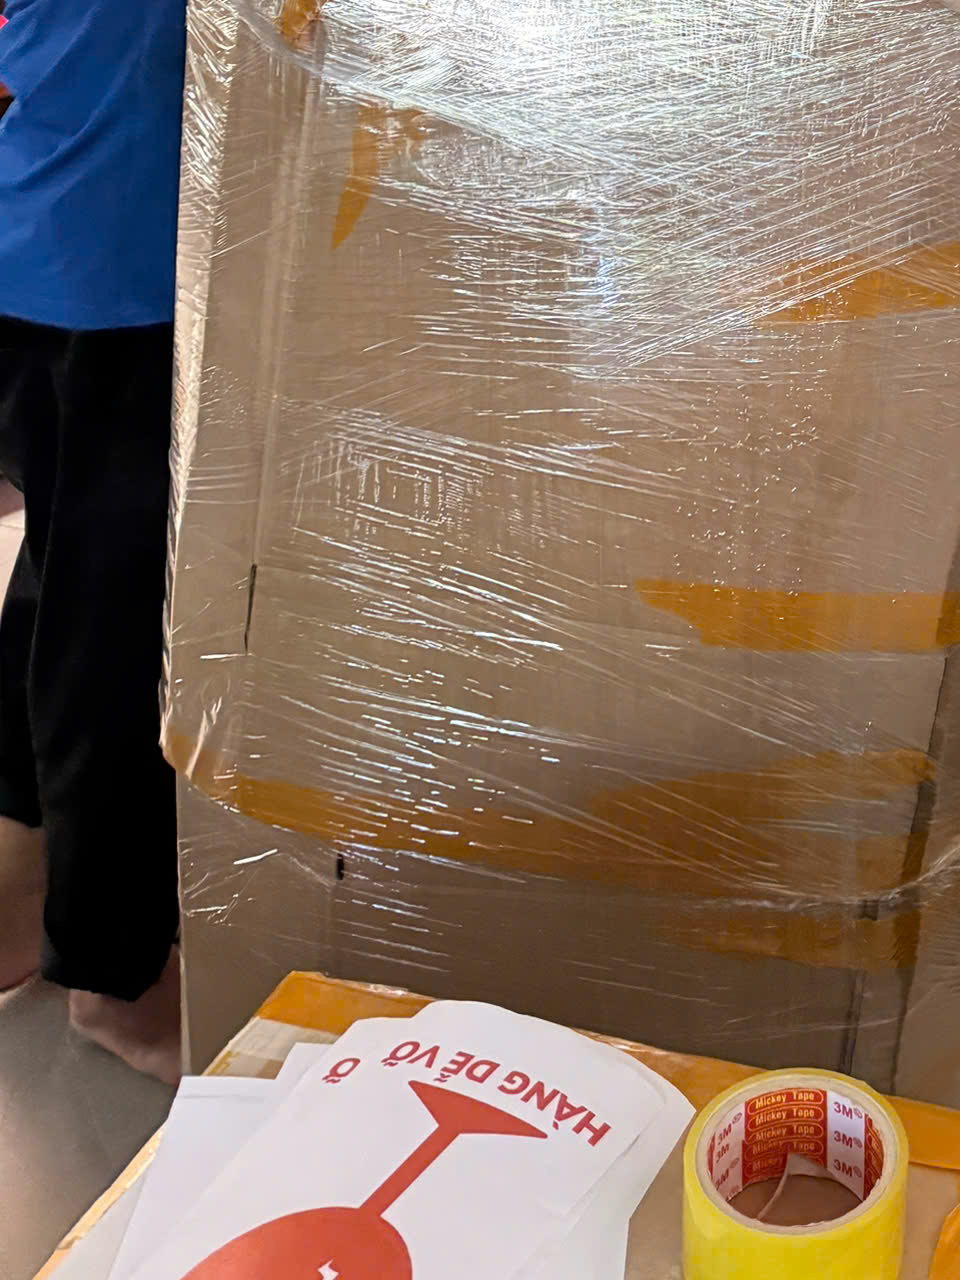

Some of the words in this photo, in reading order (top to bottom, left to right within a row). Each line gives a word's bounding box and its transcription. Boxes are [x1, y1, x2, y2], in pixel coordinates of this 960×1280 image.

[381, 1041, 440, 1069] VỠ
[433, 1051, 501, 1083] DỄ
[497, 1070, 612, 1147] HÀNG
[754, 1093, 787, 1109] Mickey
[792, 1091, 815, 1102] Tape
[754, 1110, 787, 1126] Mickey
[792, 1108, 815, 1118] Tape
[754, 1126, 787, 1142] Mickey
[792, 1125, 815, 1135] Tape
